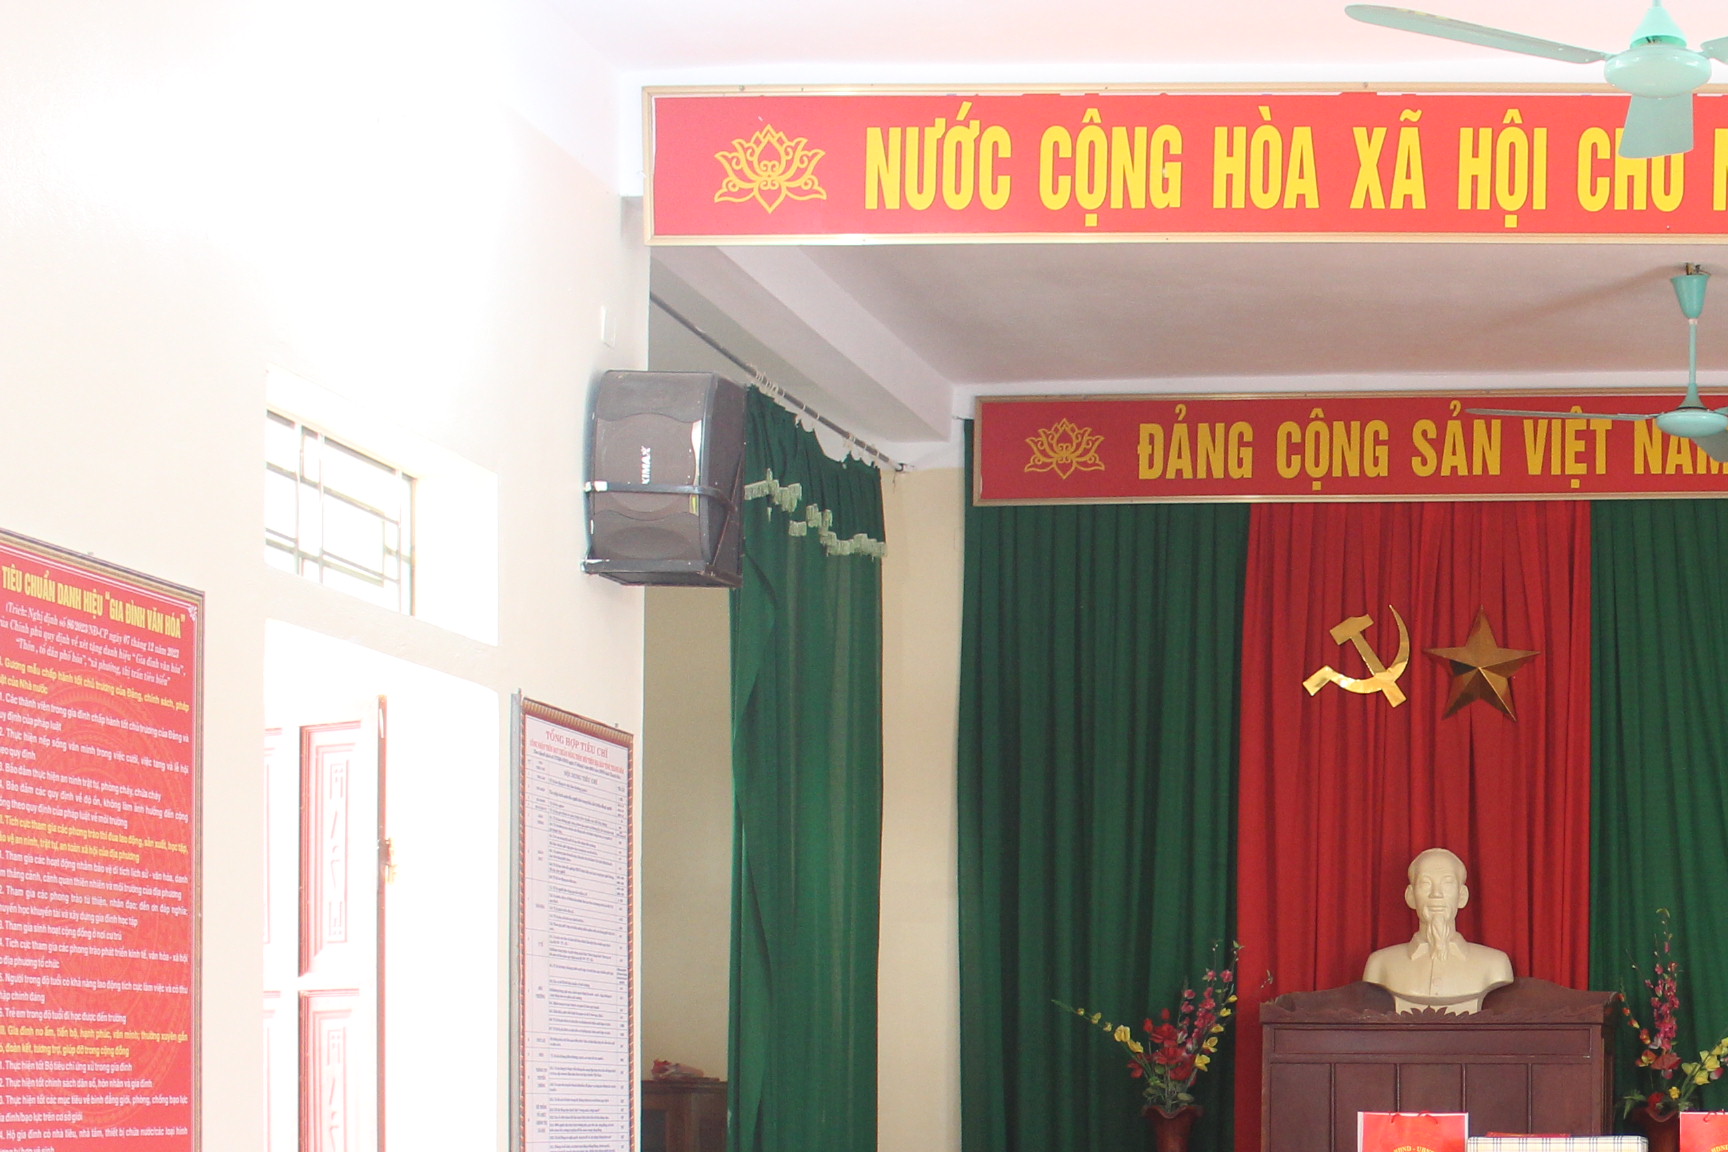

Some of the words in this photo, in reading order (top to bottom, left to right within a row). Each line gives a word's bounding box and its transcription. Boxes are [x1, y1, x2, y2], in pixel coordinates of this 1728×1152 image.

[866, 102, 1012, 210] NƯỚC
[1040, 108, 1183, 226] CỘNG
[1213, 106, 1319, 209] HÒA
[1350, 110, 1426, 209] XÃ
[1458, 109, 1548, 228] HỘI
[1137, 404, 1253, 479] ĐẢNG
[1276, 408, 1389, 490] CỘNG
[1411, 400, 1502, 476] SẢN
[1523, 406, 1613, 488] VIỆT
[1, 562, 22, 593] TIÊU
[24, 567, 55, 603] CHUẨN
[57, 582, 81, 610] DANH
[83, 585, 102, 621] HIỆU
[125, 598, 145, 628] ĐÌNH
[146, 605, 163, 633] VĂN
